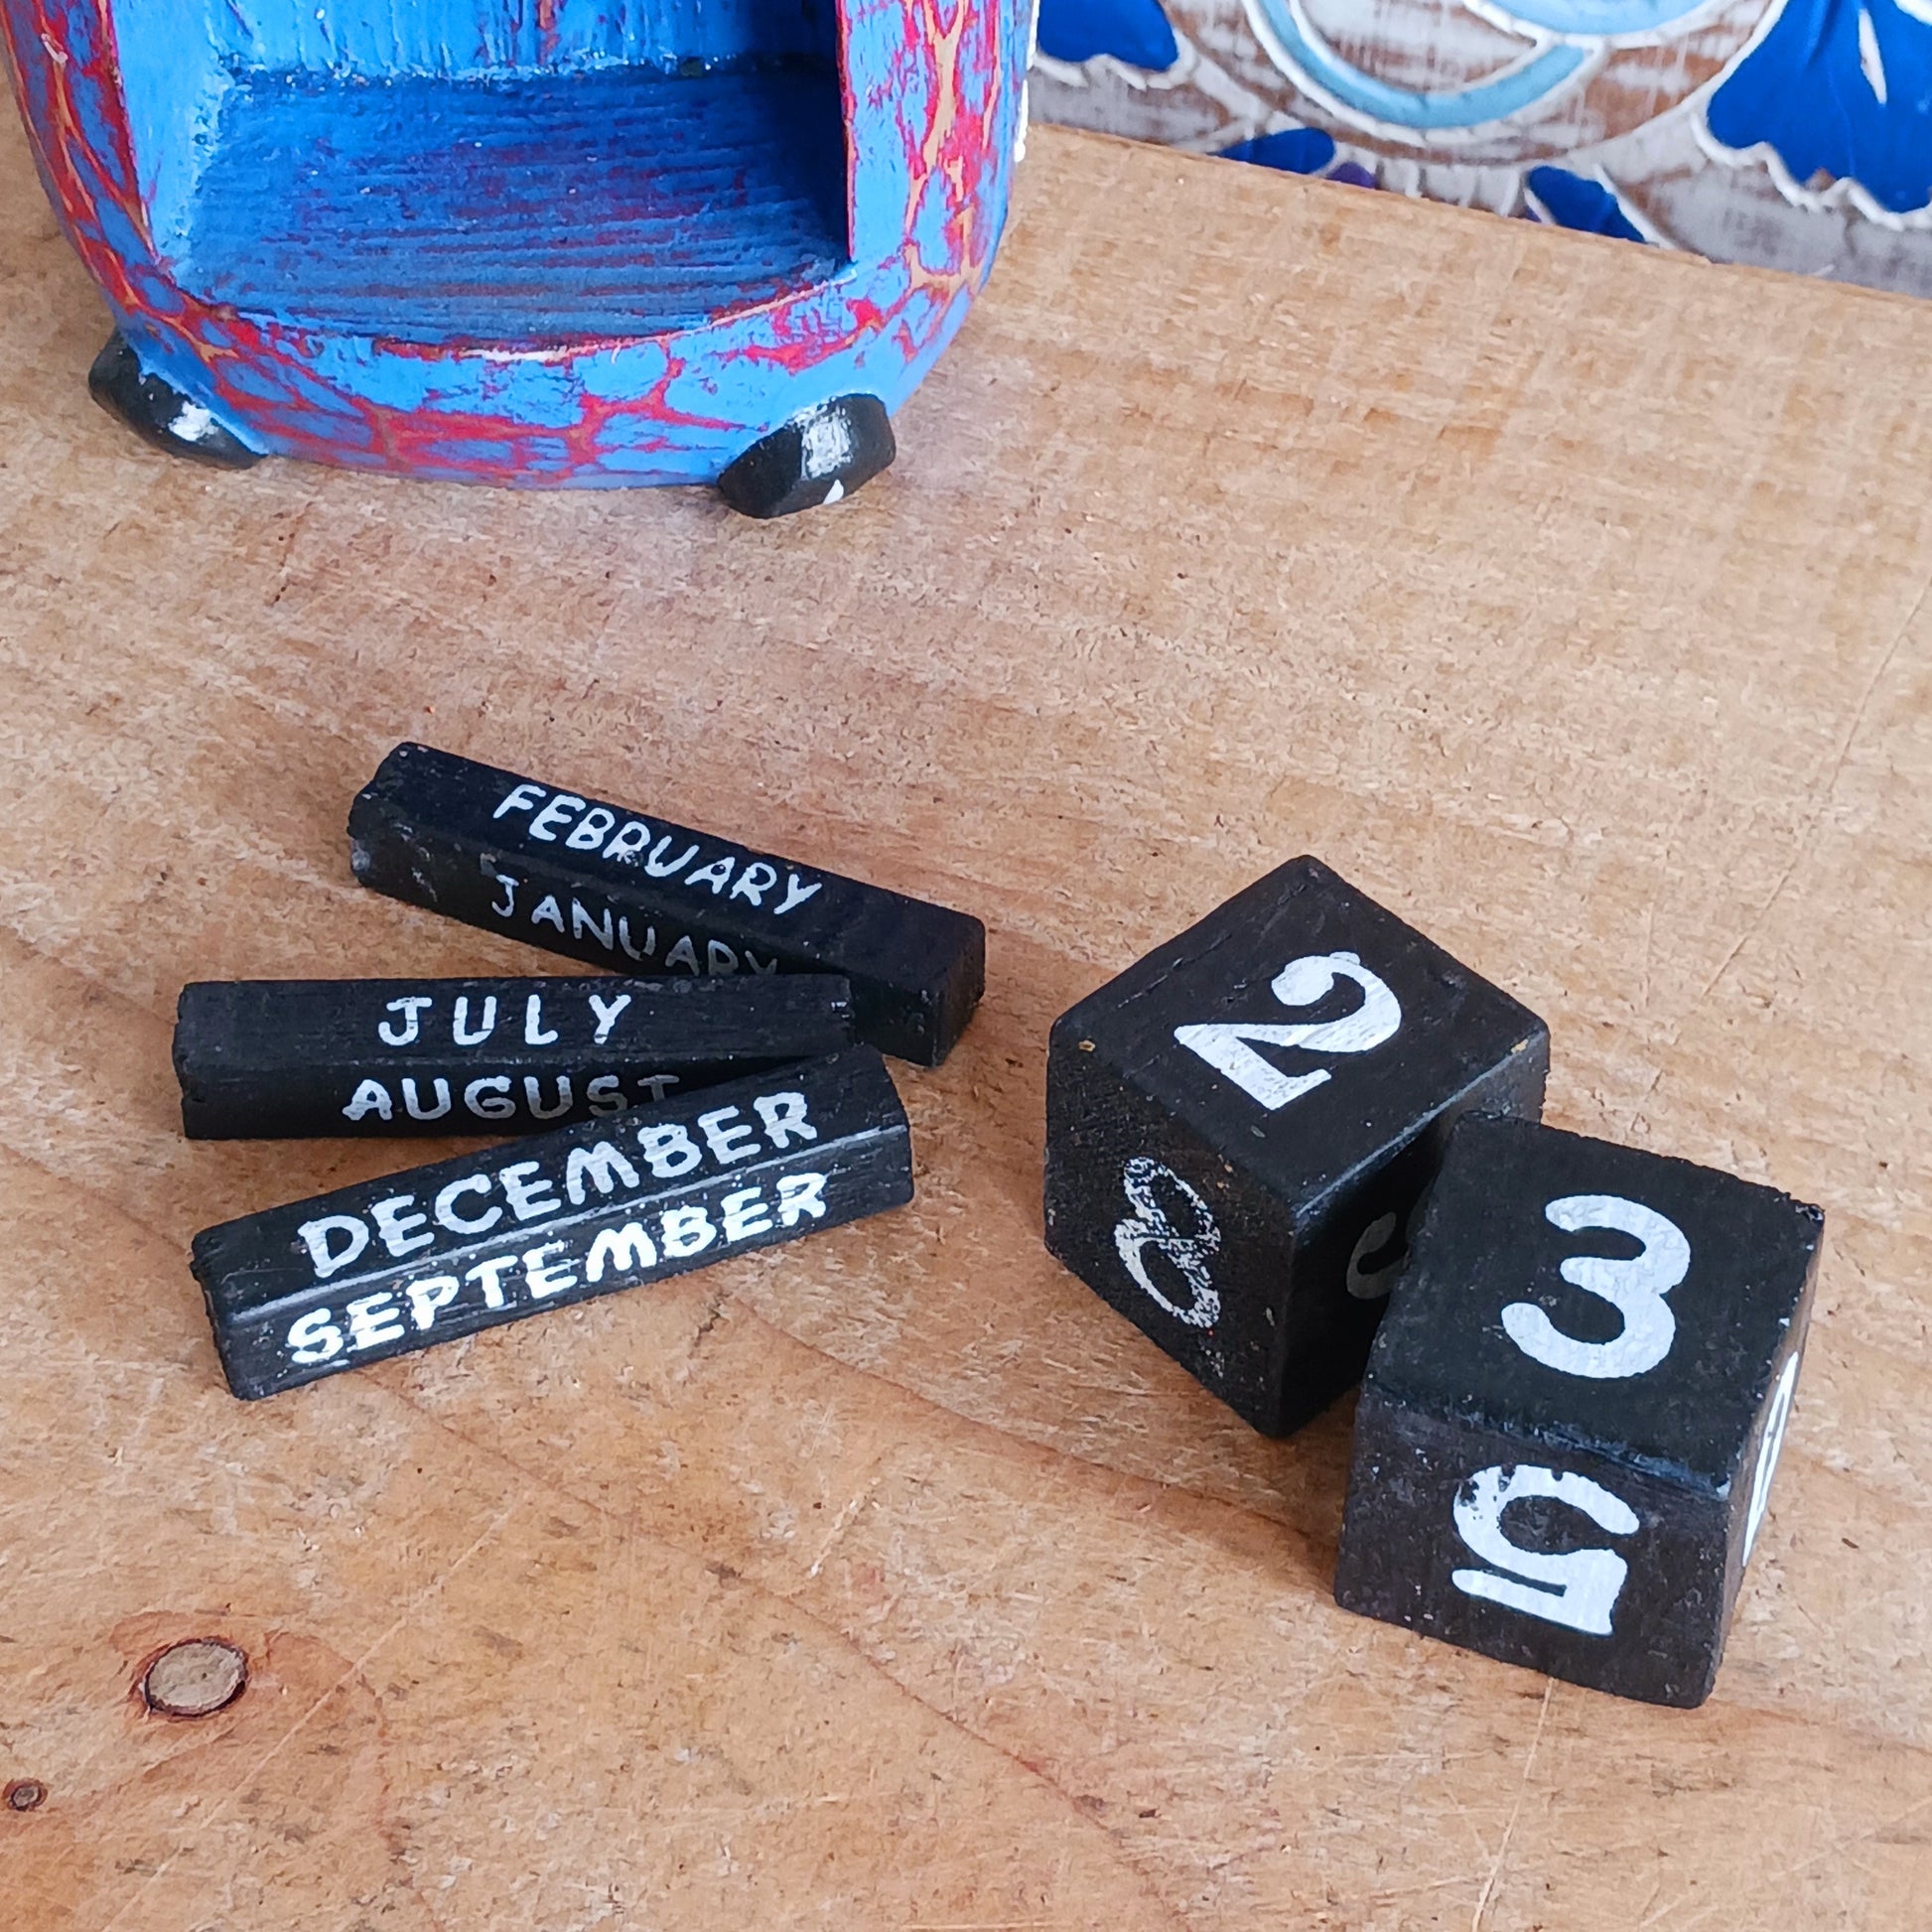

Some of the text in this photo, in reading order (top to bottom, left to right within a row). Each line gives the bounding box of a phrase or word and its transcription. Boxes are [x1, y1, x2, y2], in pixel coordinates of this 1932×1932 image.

[492, 784, 823, 914] FEBRUARY
[343, 1074, 680, 1121] AUGUST
[378, 994, 632, 1047] JULY
[1173, 951, 1402, 1111] 2
[285, 1172, 830, 1365] SEPTEMBER
[298, 1091, 818, 1279] DECEMBER
[1113, 1156, 1222, 1329] 8
[1500, 1194, 1691, 1379] 3
[1451, 1464, 1640, 1636] 5
